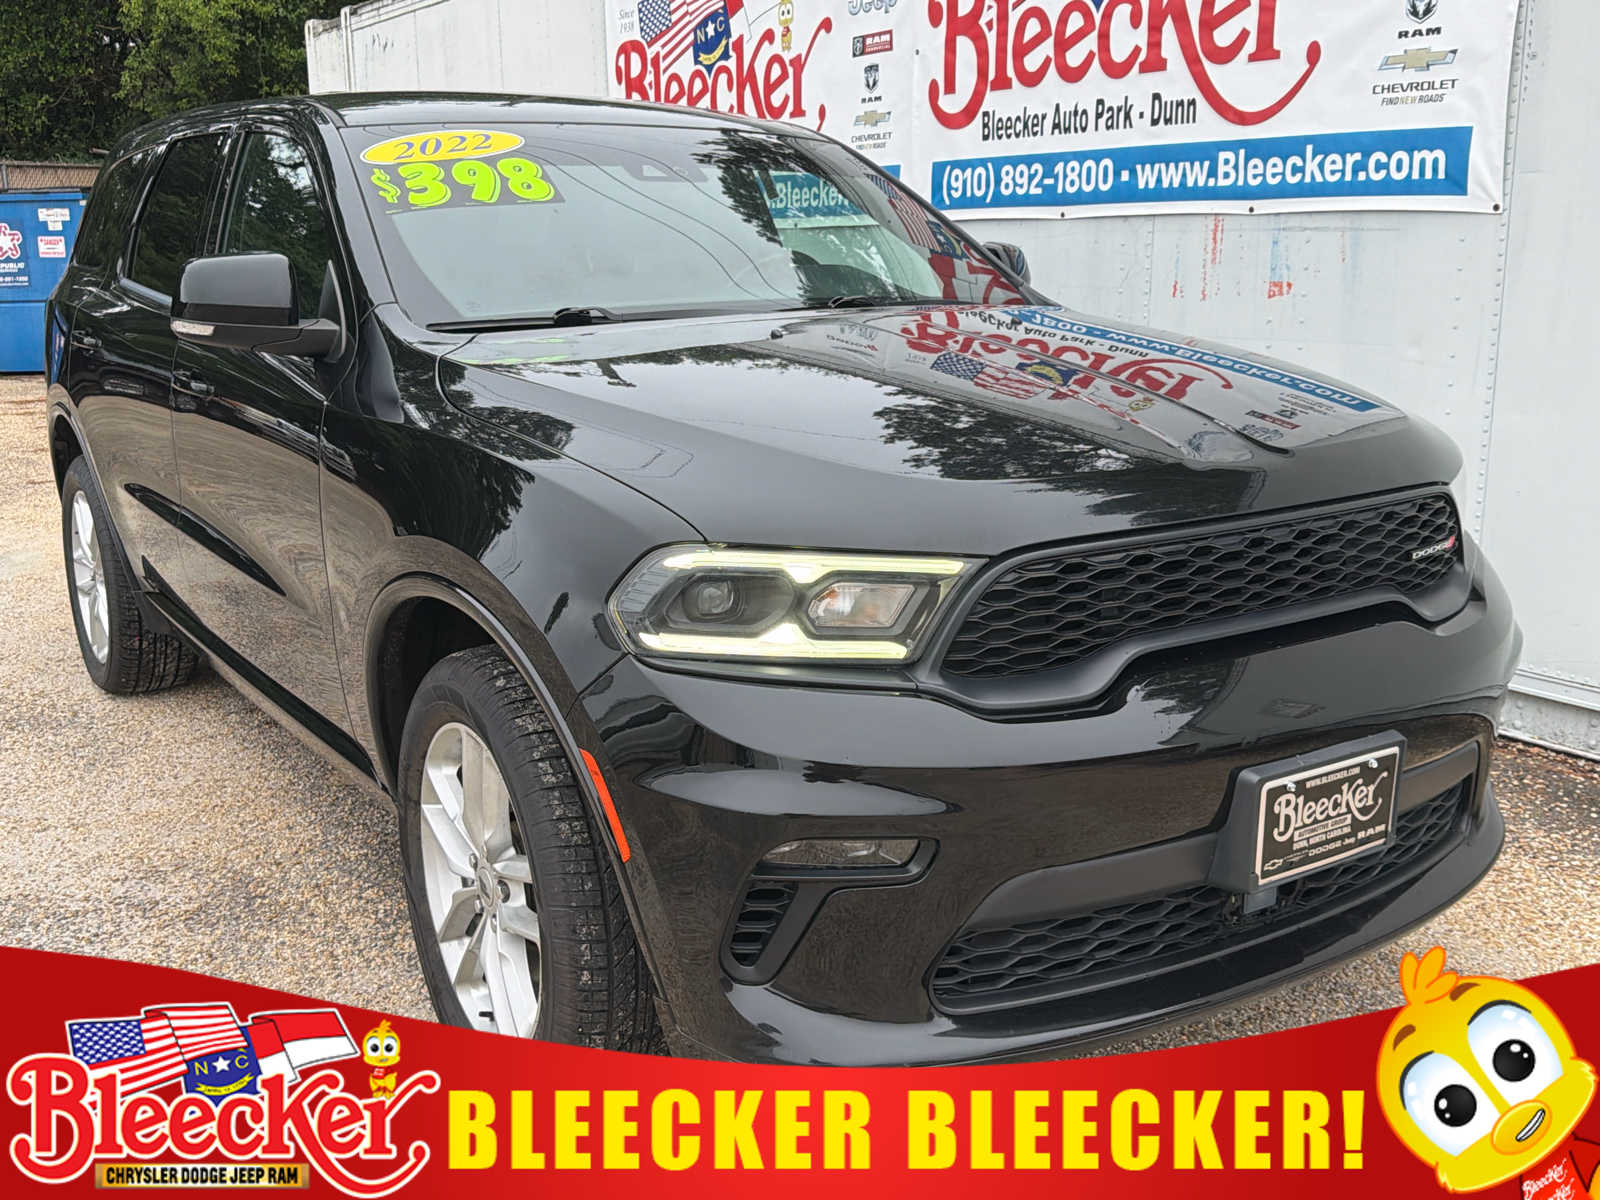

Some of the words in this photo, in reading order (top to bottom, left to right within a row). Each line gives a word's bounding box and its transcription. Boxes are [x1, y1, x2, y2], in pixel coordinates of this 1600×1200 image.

[1398, 26, 1442, 39] RAM
[615, 17, 832, 132] Bleecker
[928, 0, 1321, 130] Bleecker
[861, 95, 882, 104] RAM
[1372, 78, 1459, 95] CHEVROLET
[1381, 96, 1400, 106] FIND
[1400, 95, 1417, 104] NEW
[1418, 93, 1447, 103] ROADS
[982, 106, 1047, 141] Bleecker
[1051, 103, 1089, 135] Auto
[1095, 95, 1134, 131] Park
[1150, 92, 1197, 127] Dunn
[393, 133, 493, 160] 2022
[851, 132, 892, 143] CHEVROLET
[370, 157, 556, 208] $398
[942, 162, 995, 205] (910)
[1000, 158, 1114, 195] 892-1800
[1136, 144, 1447, 189] www.Bleecker.com
[1412, 543, 1449, 560] DODGE
[1273, 771, 1388, 842] Bleecker
[1308, 840, 1342, 857] DODGE
[1357, 824, 1386, 840] RAM
